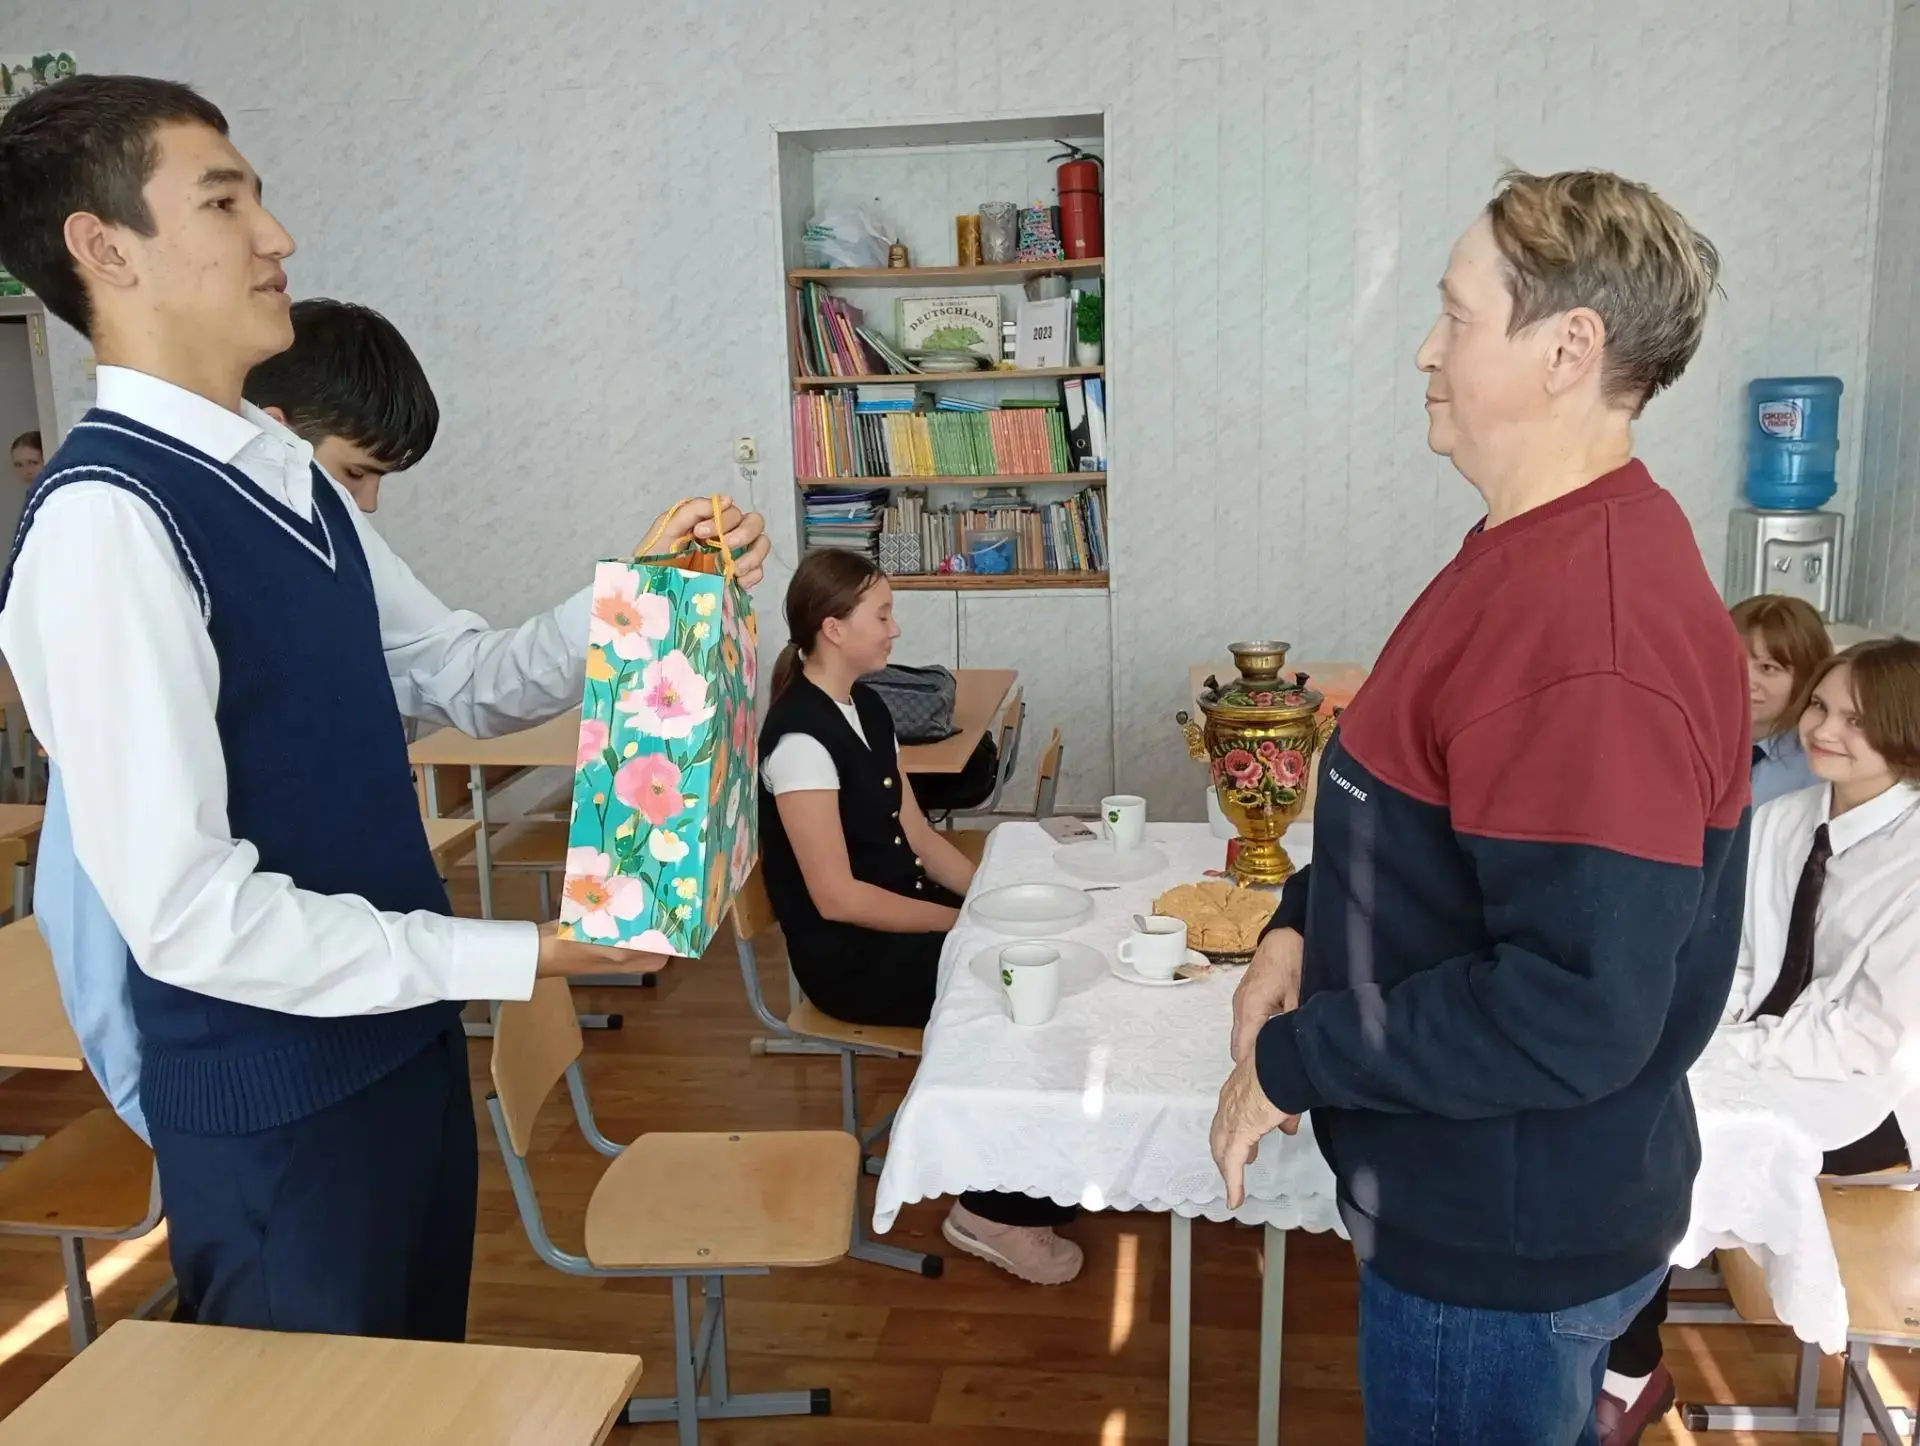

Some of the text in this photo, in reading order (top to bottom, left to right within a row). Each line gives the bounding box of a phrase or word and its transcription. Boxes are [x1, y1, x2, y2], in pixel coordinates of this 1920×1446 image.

[909, 307, 994, 331] DEUTSCHLAND
[1033, 325, 1053, 340] 2023
[1336, 776, 1351, 790] AND
